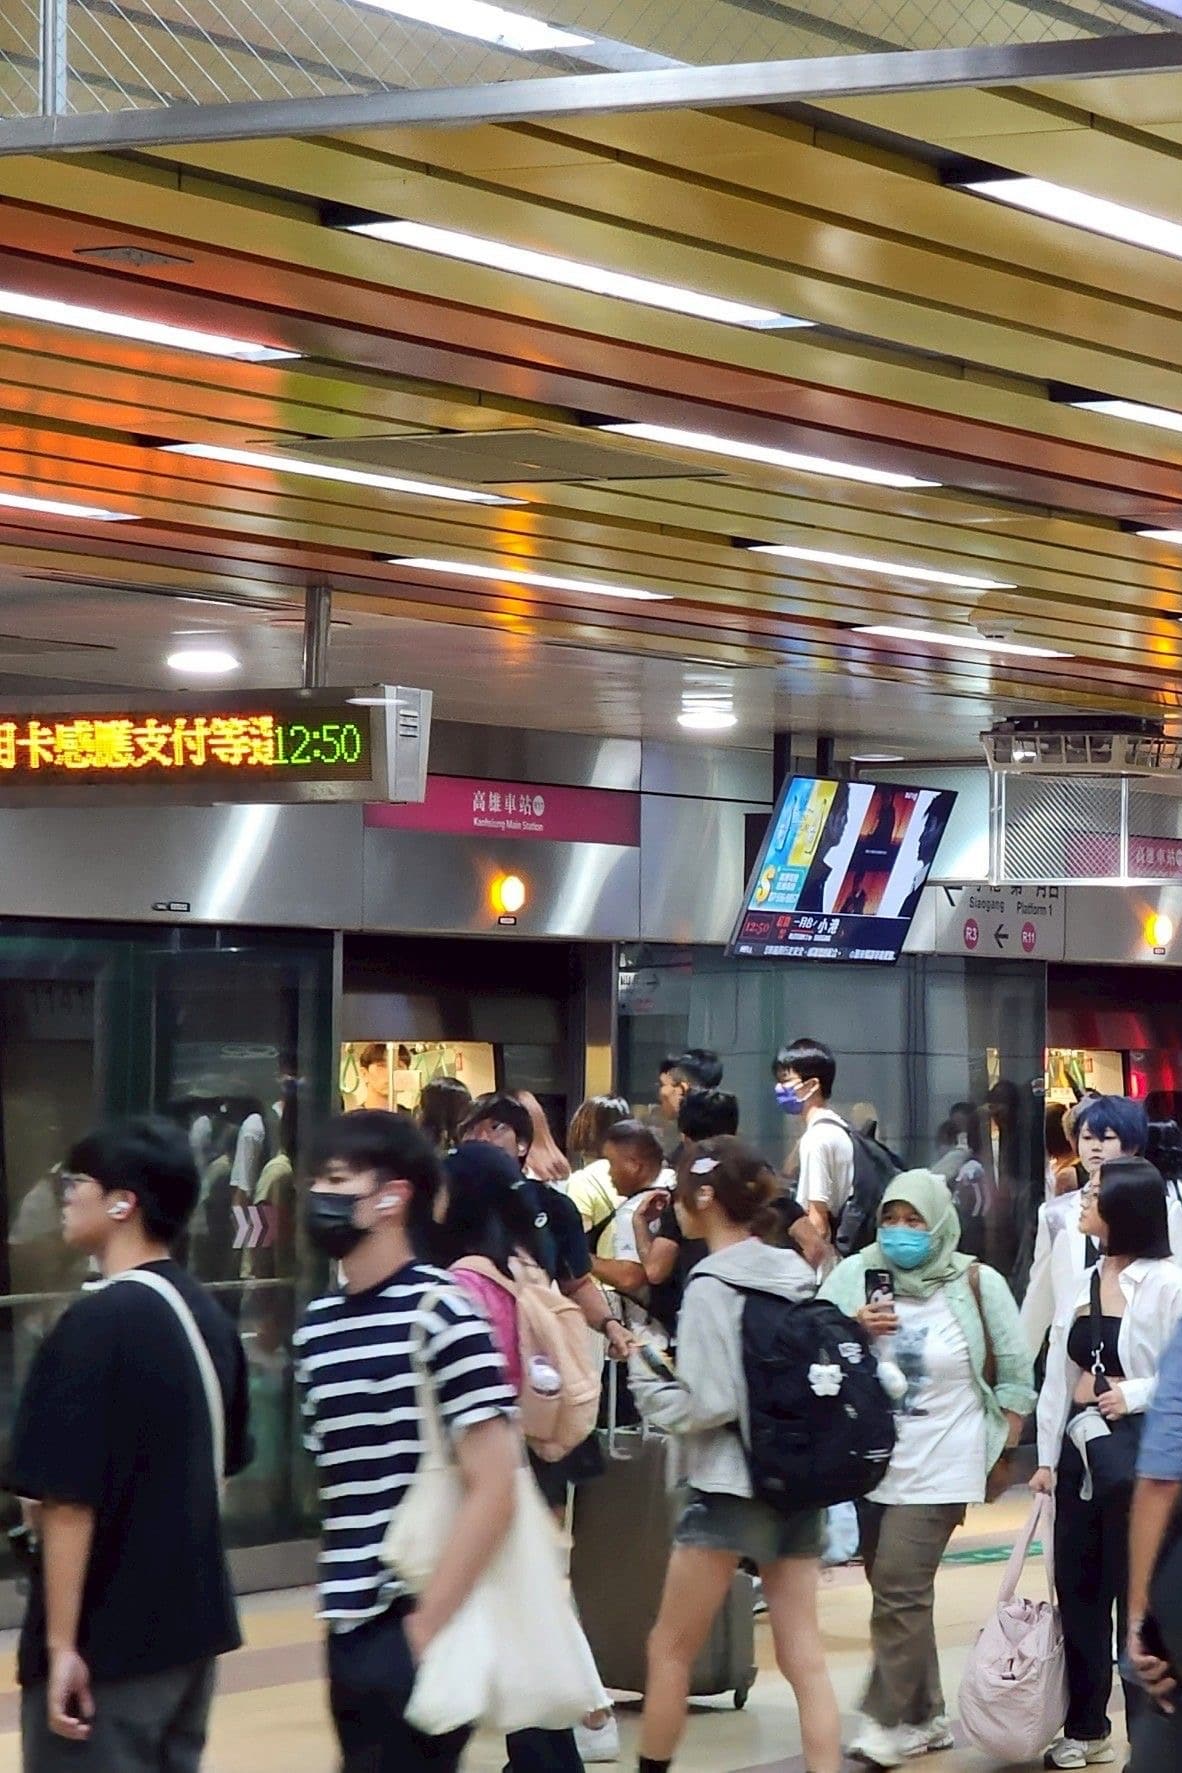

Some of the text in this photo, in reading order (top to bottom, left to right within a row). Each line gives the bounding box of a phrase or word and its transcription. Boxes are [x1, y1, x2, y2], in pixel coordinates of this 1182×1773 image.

[273, 725, 361, 763] 12:50
[472, 790, 533, 816] 高雄車站
[965, 926, 977, 941] R3
[1022, 931, 1035, 943] R11
